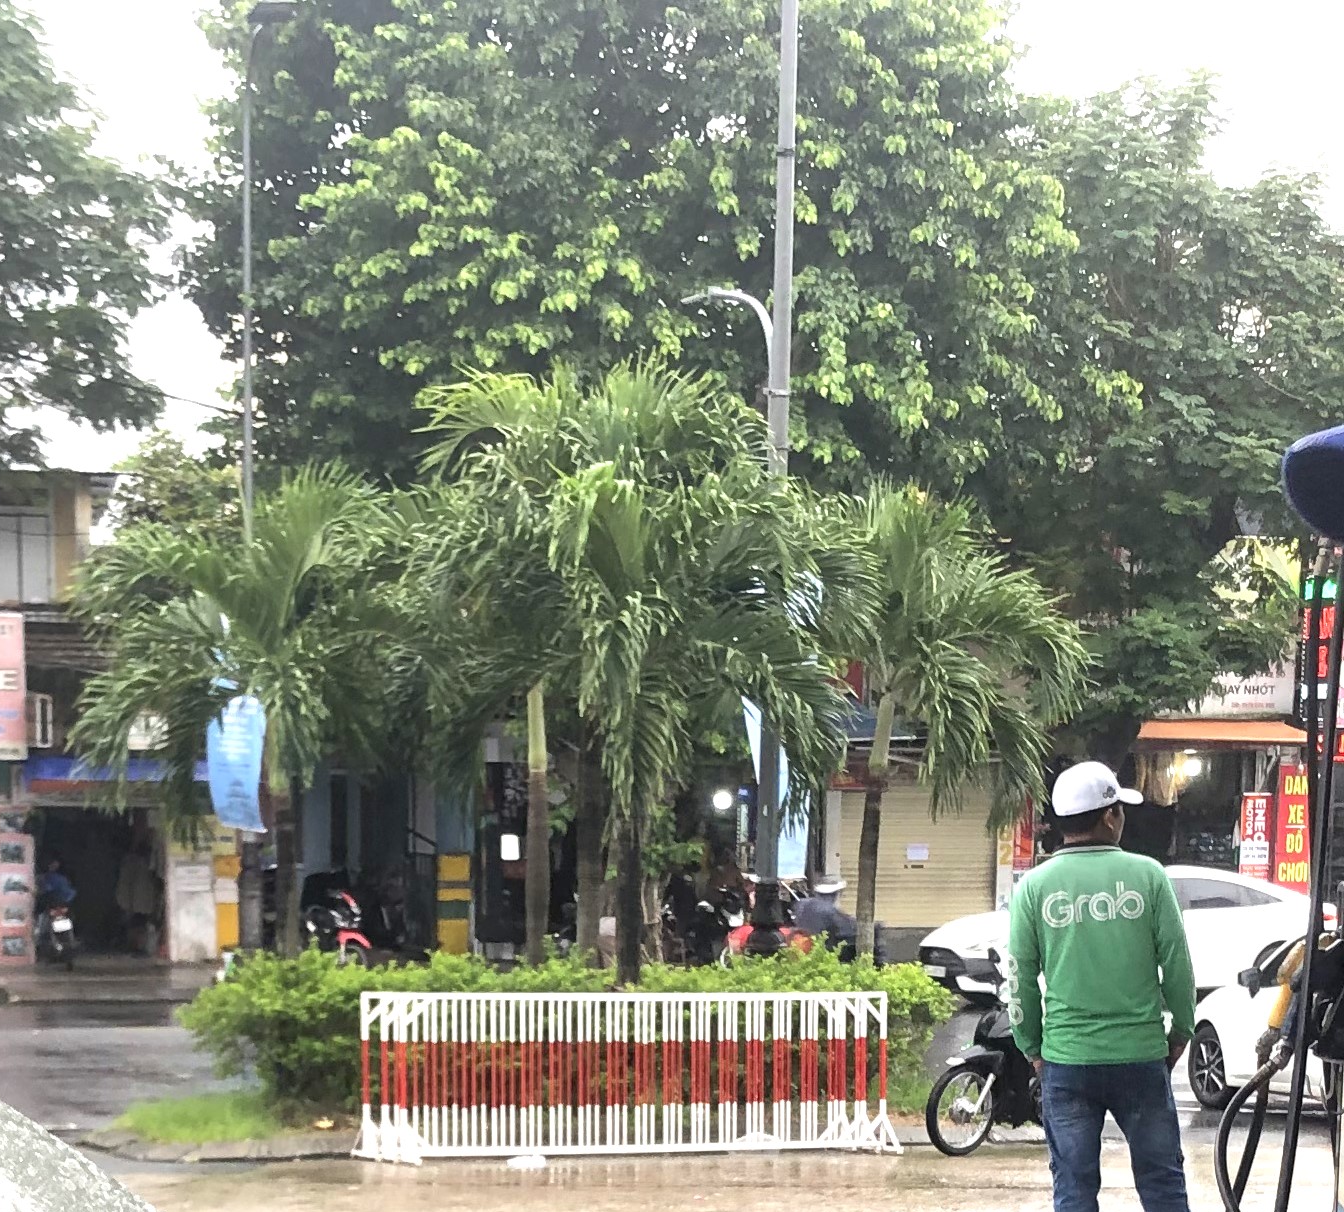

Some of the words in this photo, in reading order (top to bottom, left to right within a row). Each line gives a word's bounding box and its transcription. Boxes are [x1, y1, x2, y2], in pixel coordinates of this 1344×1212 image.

[1288, 804, 1305, 824] XE
[1277, 861, 1308, 883] CHƠI
[1041, 880, 1145, 928] Grab
